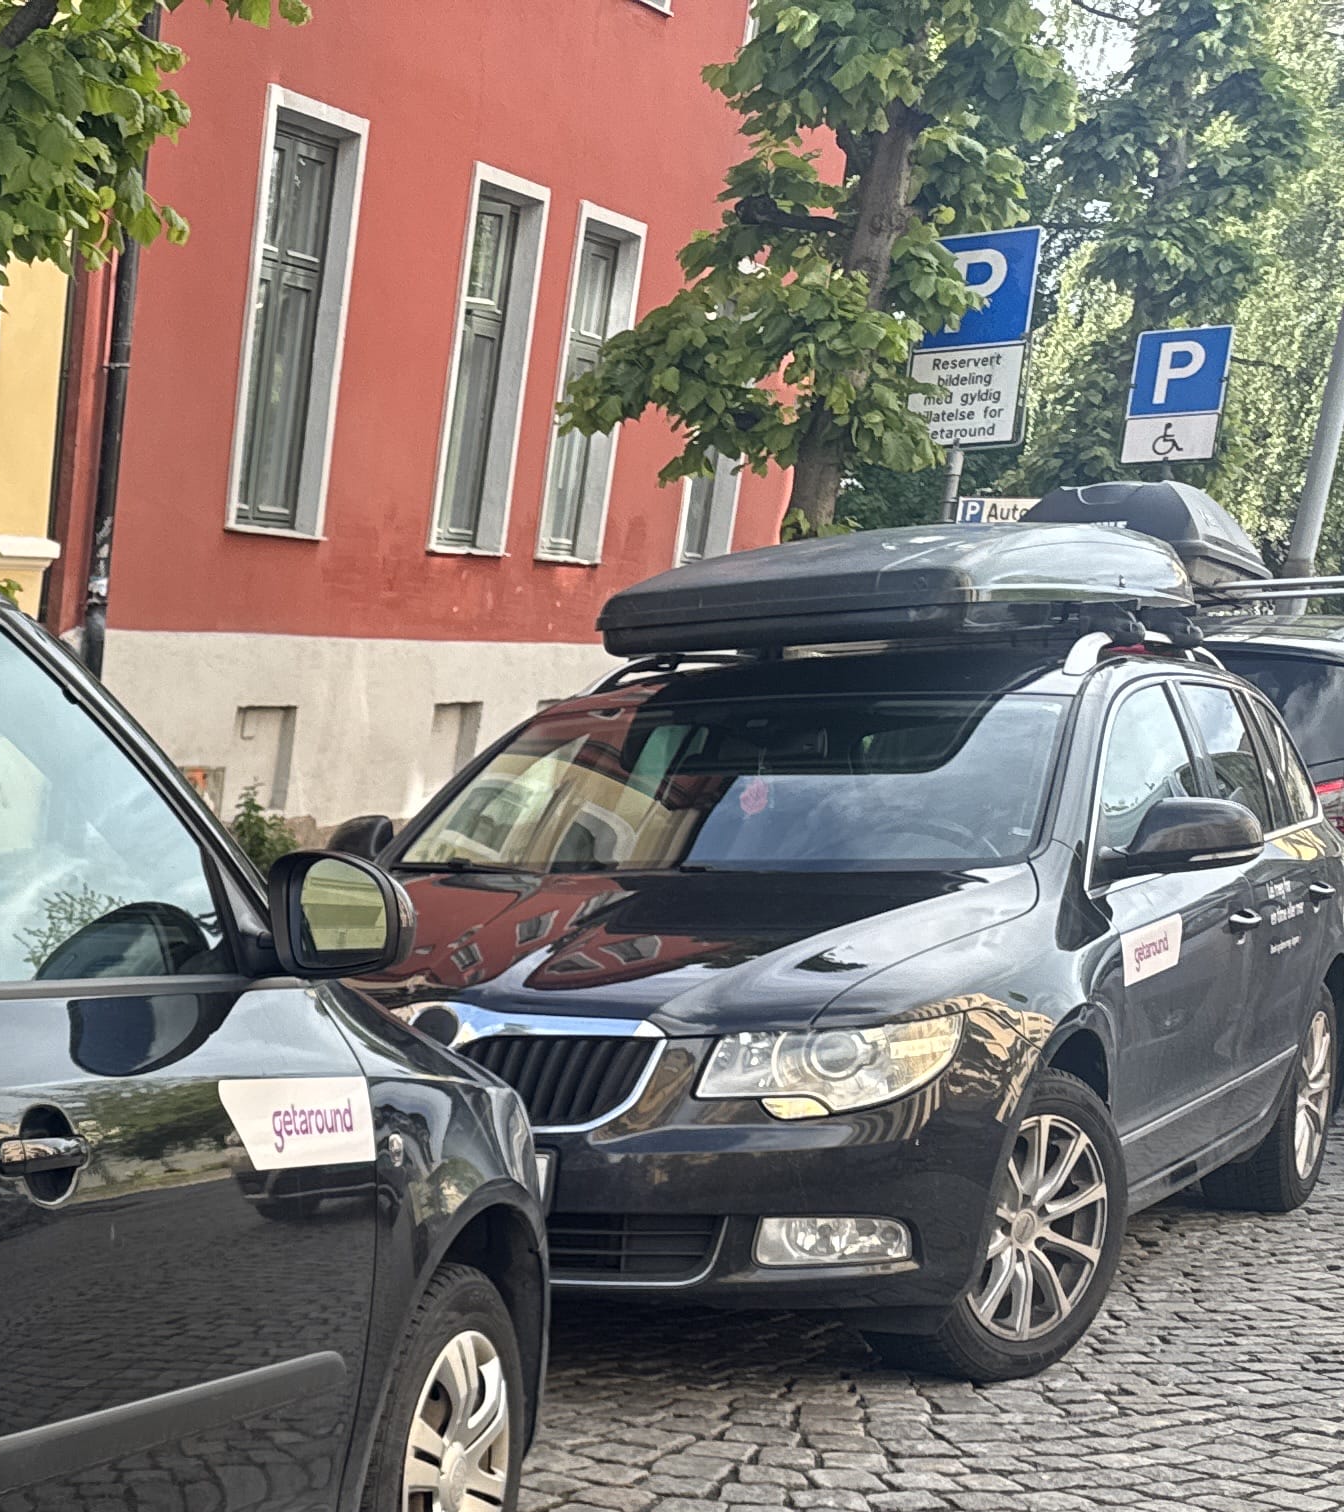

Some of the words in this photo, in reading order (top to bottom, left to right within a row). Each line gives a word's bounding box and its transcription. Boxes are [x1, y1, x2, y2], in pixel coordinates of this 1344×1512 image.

[932, 353, 1002, 371] Reservert
[937, 372, 993, 387] bildeling
[1152, 341, 1206, 405] P
[960, 388, 1001, 406] gyldig
[983, 406, 1004, 419] for
[930, 424, 996, 440] etaround
[272, 1098, 354, 1153] getaround
